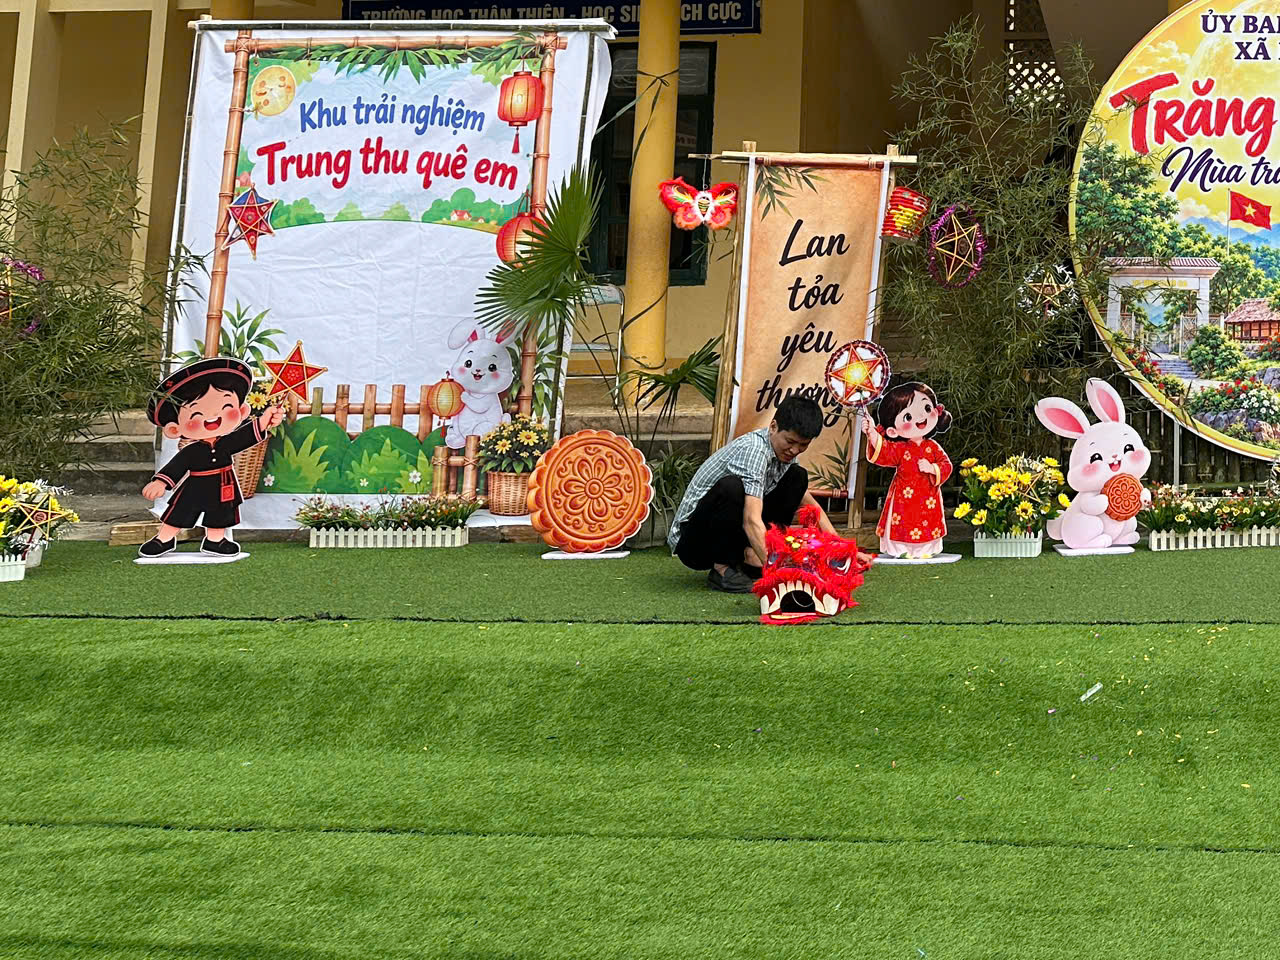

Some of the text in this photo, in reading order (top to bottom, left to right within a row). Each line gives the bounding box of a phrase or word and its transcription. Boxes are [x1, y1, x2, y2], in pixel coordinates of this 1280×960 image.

[620, 4, 640, 23] SI
[681, 3, 703, 22] CH
[708, 1, 742, 24] CỰC
[1203, 10, 1235, 32] ỦY
[1235, 38, 1270, 60] XÃ
[301, 94, 484, 135] Khu trải nghiệm
[257, 138, 517, 189] Trung thu quê em
[1160, 147, 1244, 193] Mùa
[779, 220, 850, 266] Lan
[788, 275, 843, 311] tỏa
[777, 323, 838, 373] yêu
